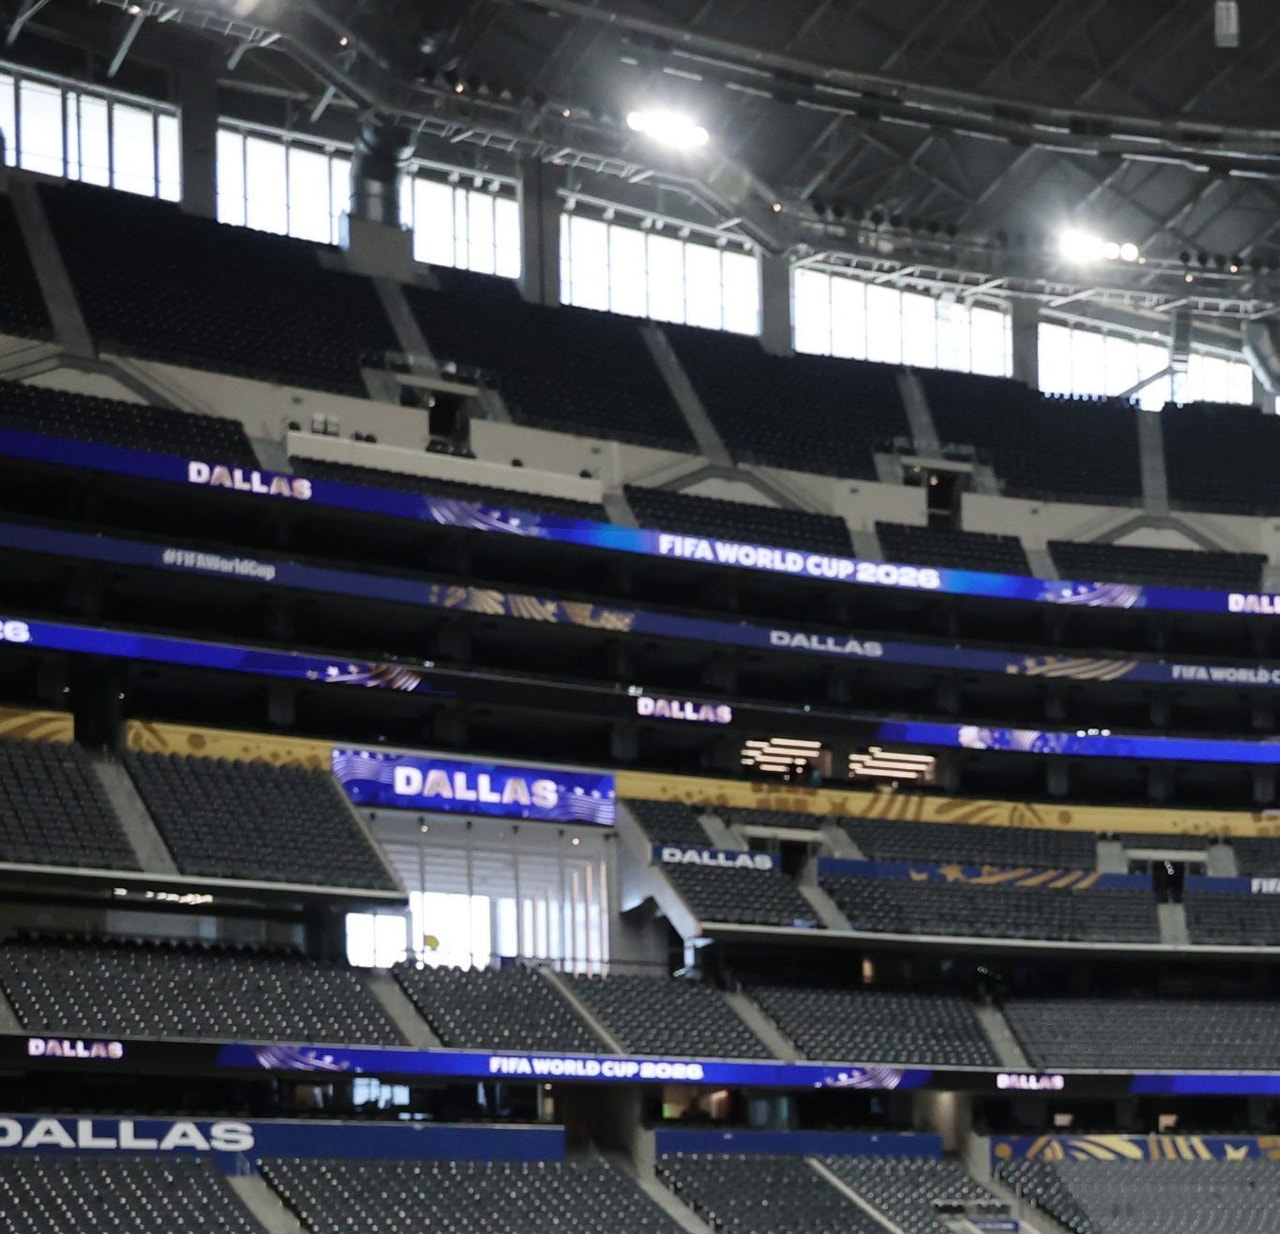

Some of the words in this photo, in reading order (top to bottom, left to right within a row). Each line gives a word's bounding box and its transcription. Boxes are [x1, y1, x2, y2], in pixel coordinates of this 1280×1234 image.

[188, 460, 312, 500] DALLAS
[659, 534, 714, 561] FIFA
[717, 542, 802, 572] WORLD
[806, 556, 854, 580] CUP
[856, 562, 939, 589] 2026
[770, 630, 883, 657] DALLAS
[1172, 665, 1208, 681] FIFA
[1211, 667, 1270, 683] WORLD
[637, 697, 732, 724] DALLAS
[395, 766, 558, 808] DALLAS
[661, 846, 774, 870] DALLAS
[28, 1037, 123, 1060] DALLAS
[490, 1056, 532, 1075] FIFA
[532, 1058, 599, 1077] WORLD
[602, 1061, 639, 1079] CUP
[640, 1063, 703, 1080] 2026
